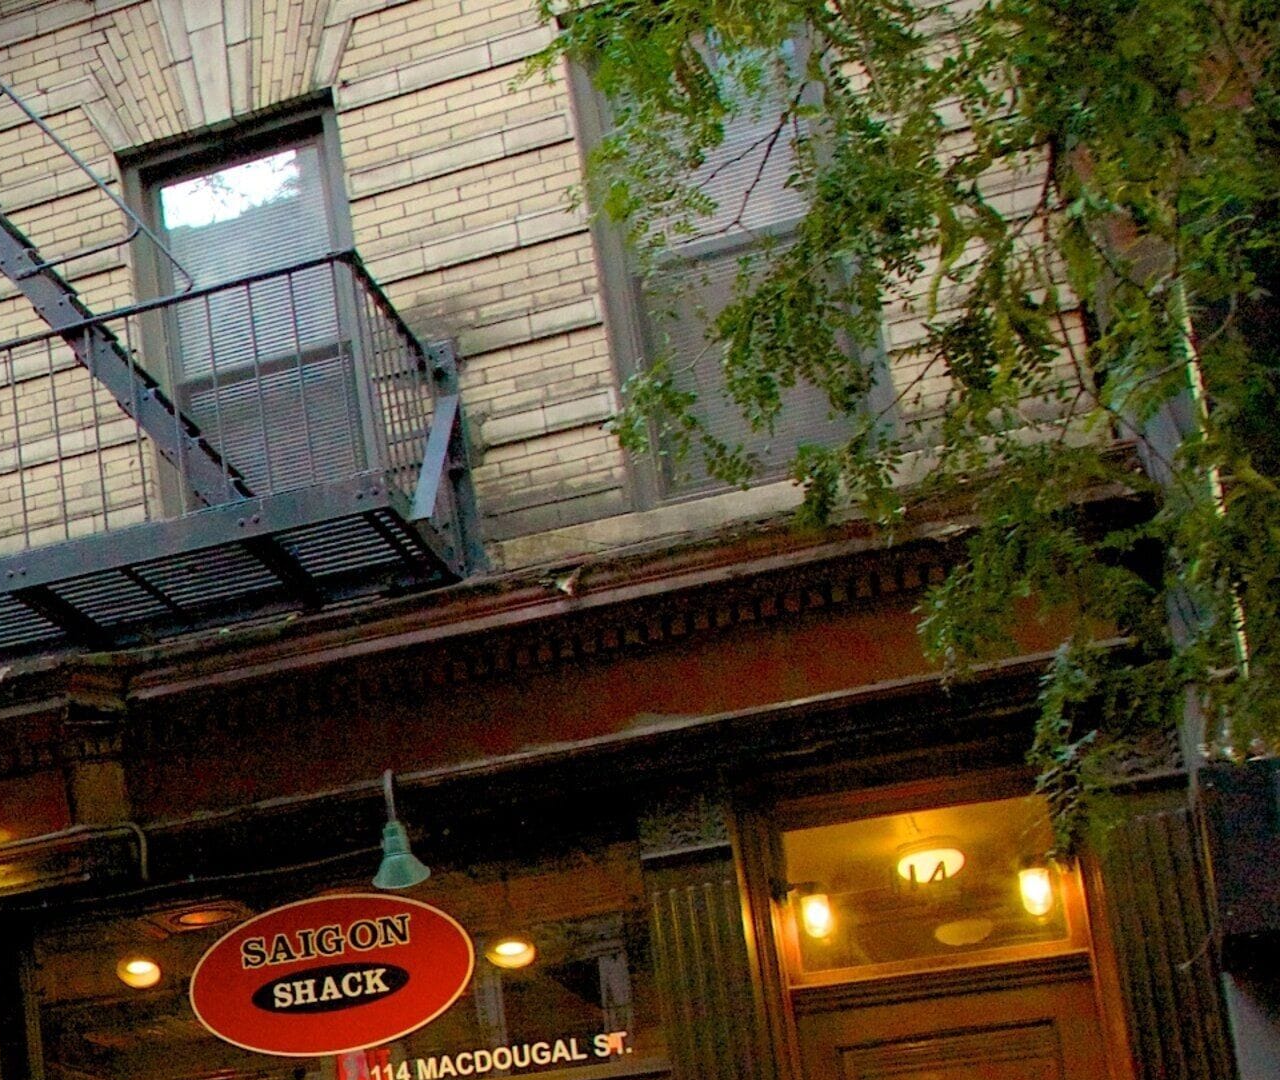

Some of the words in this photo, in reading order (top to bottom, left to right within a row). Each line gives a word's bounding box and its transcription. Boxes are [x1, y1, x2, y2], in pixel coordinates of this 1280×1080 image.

[242, 913, 410, 969] SAIGON
[273, 968, 390, 1009] SHACK
[417, 1037, 588, 1080] MACDOUGAL
[593, 1031, 634, 1058] ST.
